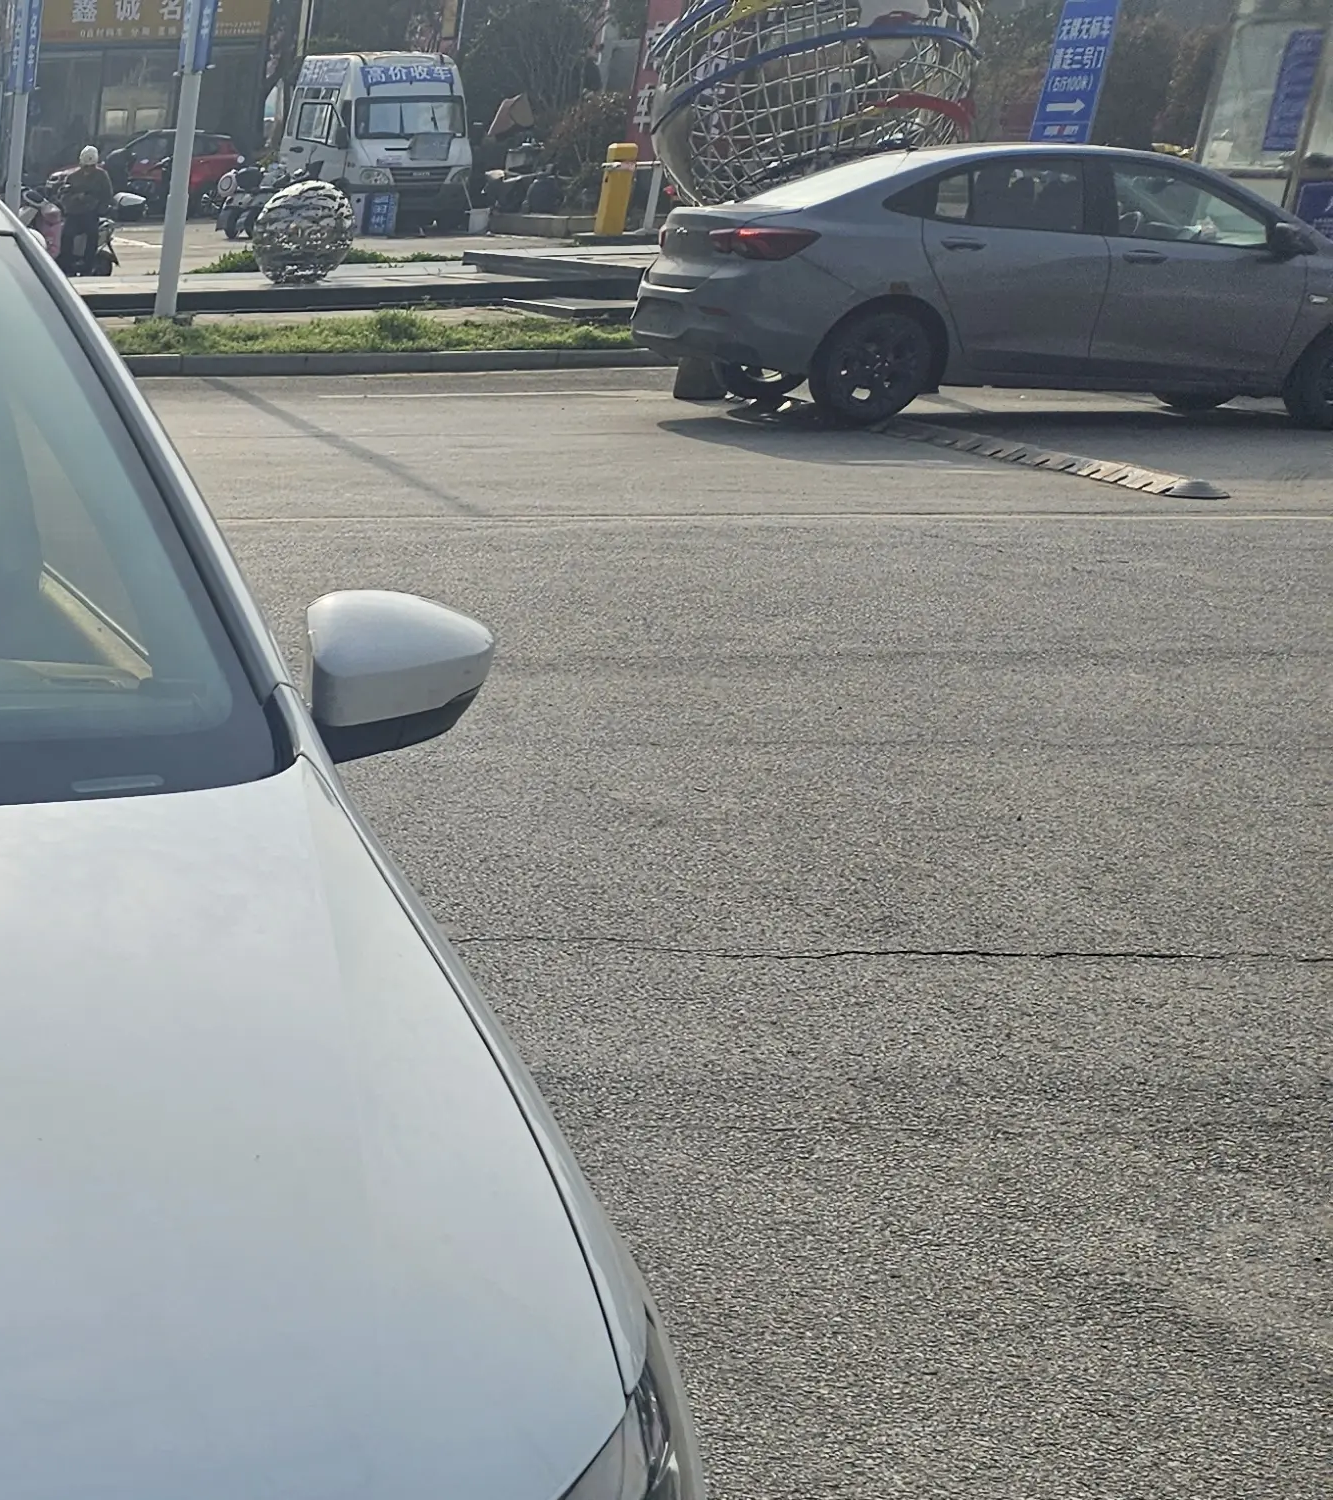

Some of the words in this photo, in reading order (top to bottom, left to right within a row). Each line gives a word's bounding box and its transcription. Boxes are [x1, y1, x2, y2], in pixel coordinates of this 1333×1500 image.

[1052, 46, 1105, 69] 请走三号门
[366, 65, 451, 83] 高价收车
